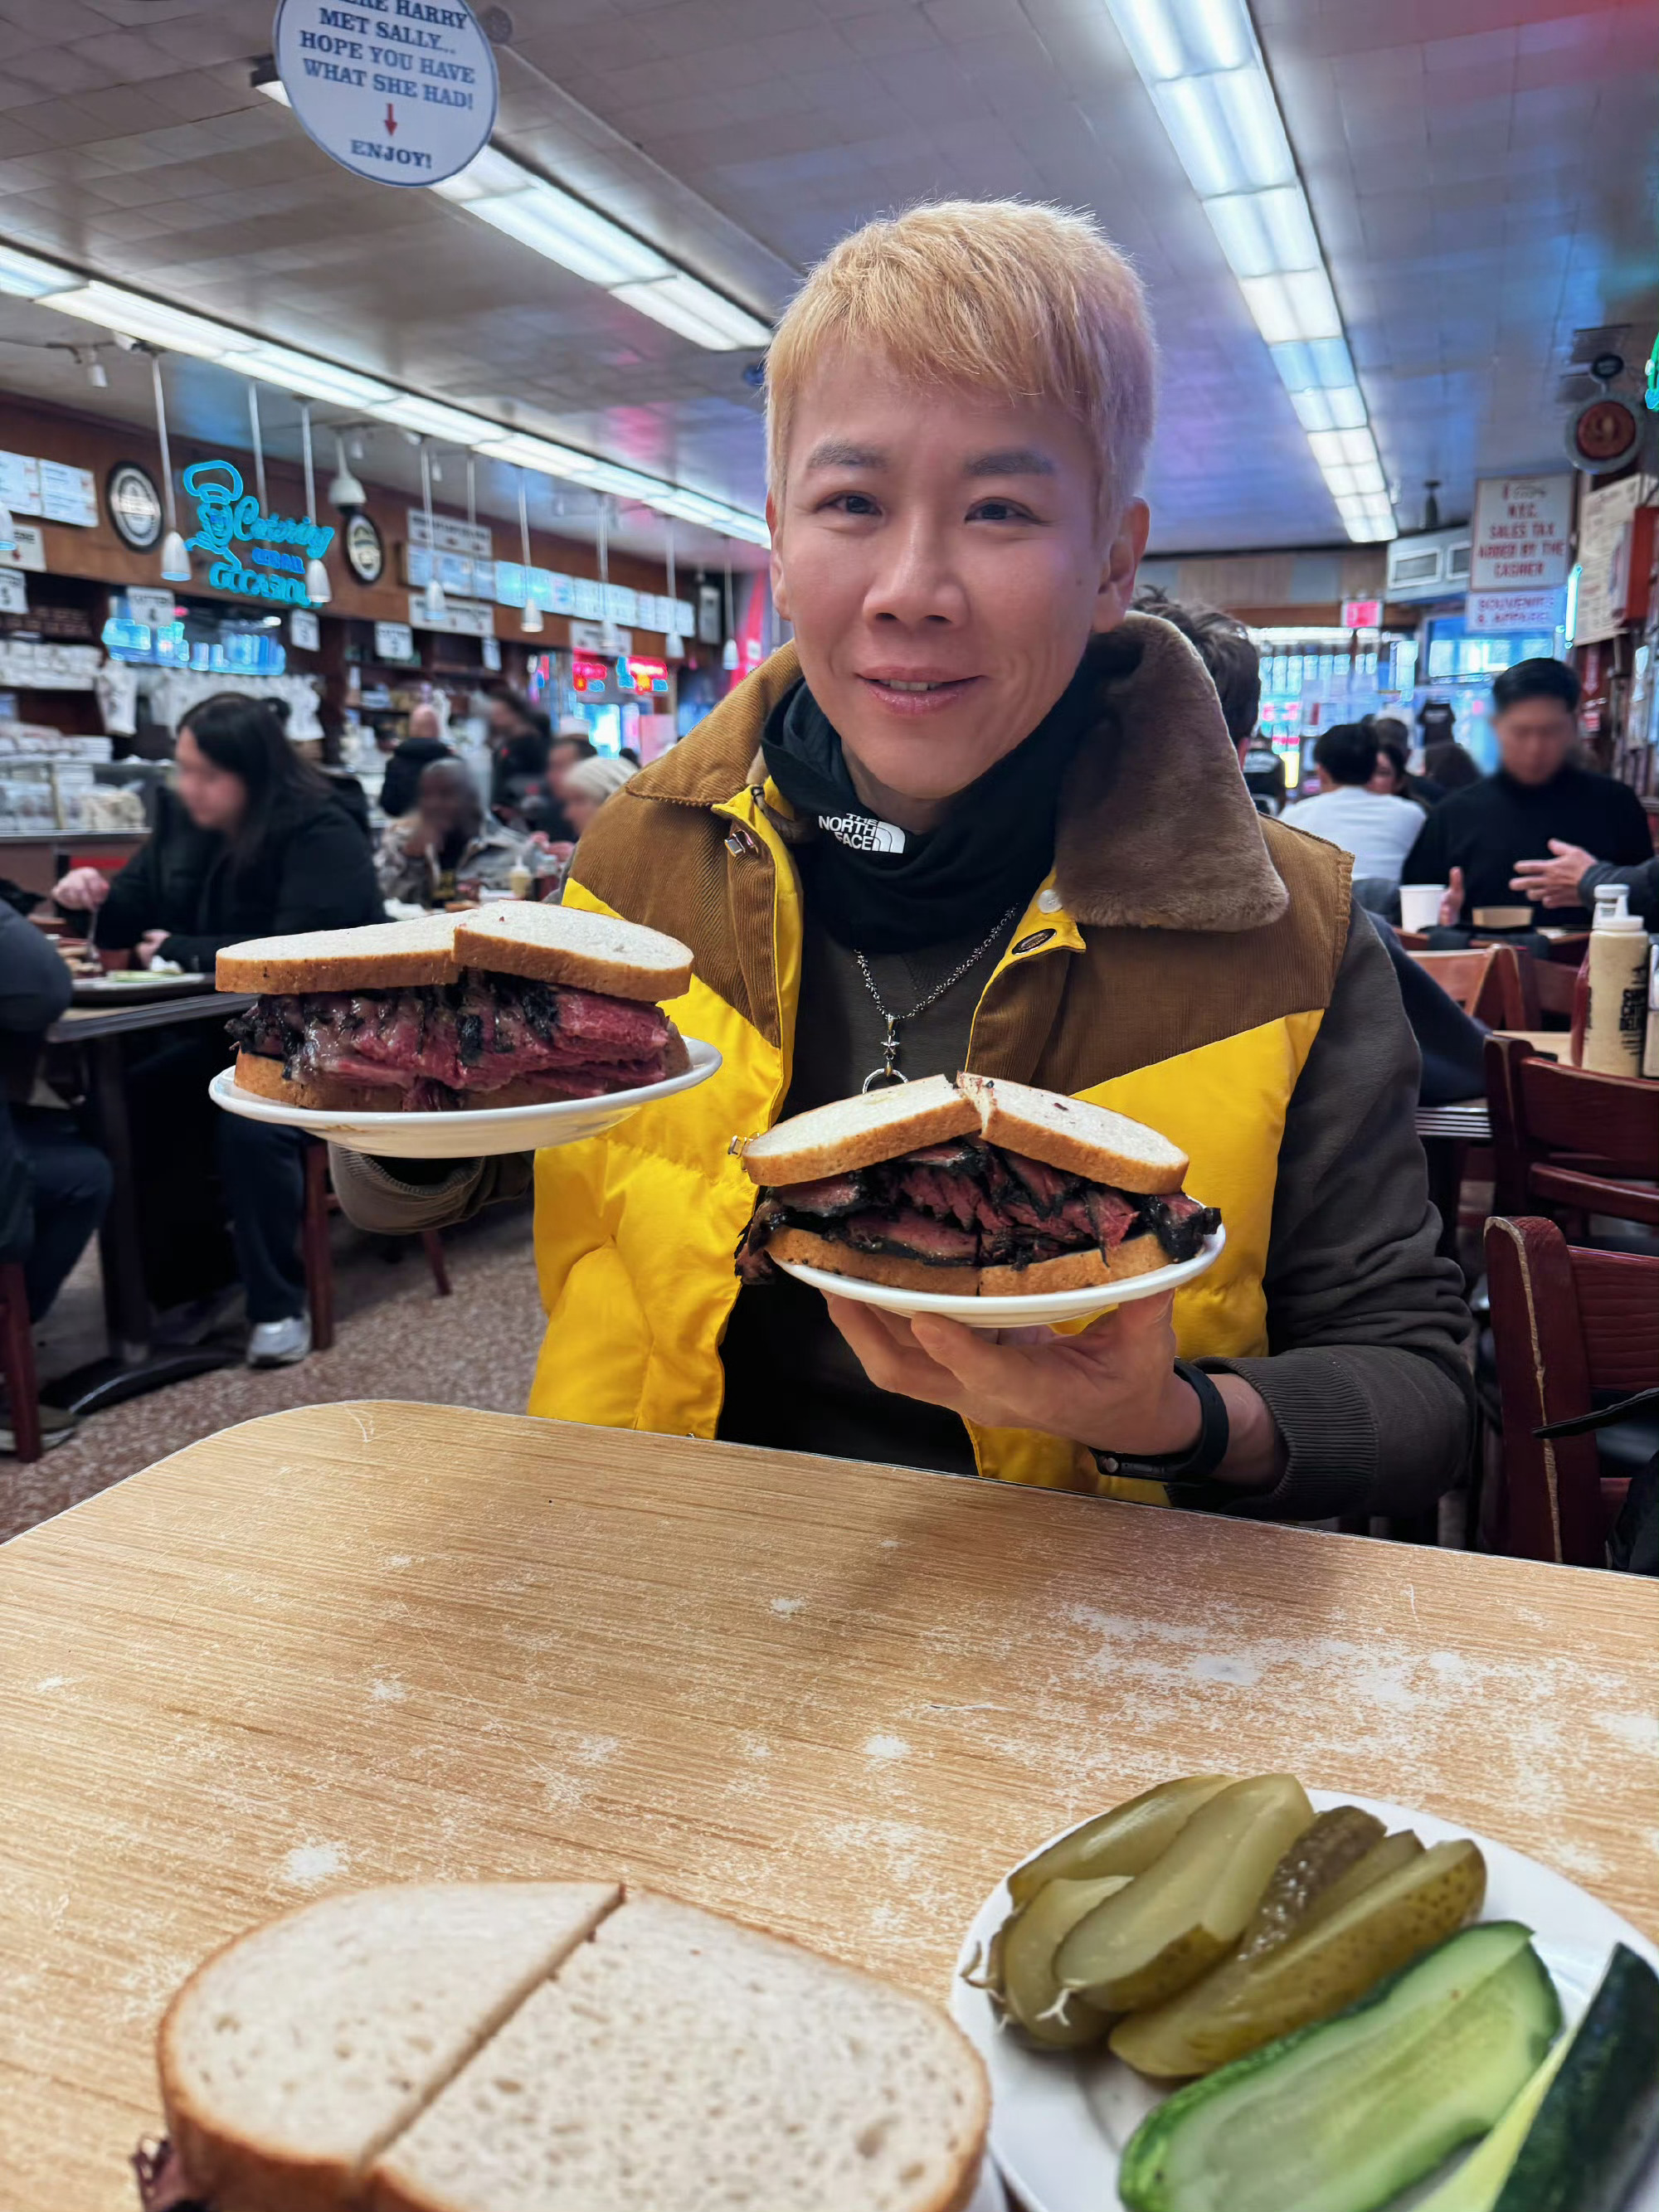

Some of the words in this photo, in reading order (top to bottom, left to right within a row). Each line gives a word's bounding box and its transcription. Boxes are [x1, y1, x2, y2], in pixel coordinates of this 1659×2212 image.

[319, 7, 370, 35] MET
[396, 0, 467, 29] HARRY
[299, 30, 363, 60] HOPE
[368, 46, 413, 71] YOU
[420, 57, 475, 84] HAVE
[303, 57, 367, 87] WHAT
[372, 74, 418, 99] SHE
[423, 84, 474, 110] HAD!
[350, 139, 432, 169] ENJOY!
[818, 815, 877, 838] NORTH
[846, 813, 878, 827] THE
[834, 831, 873, 852] FACE
